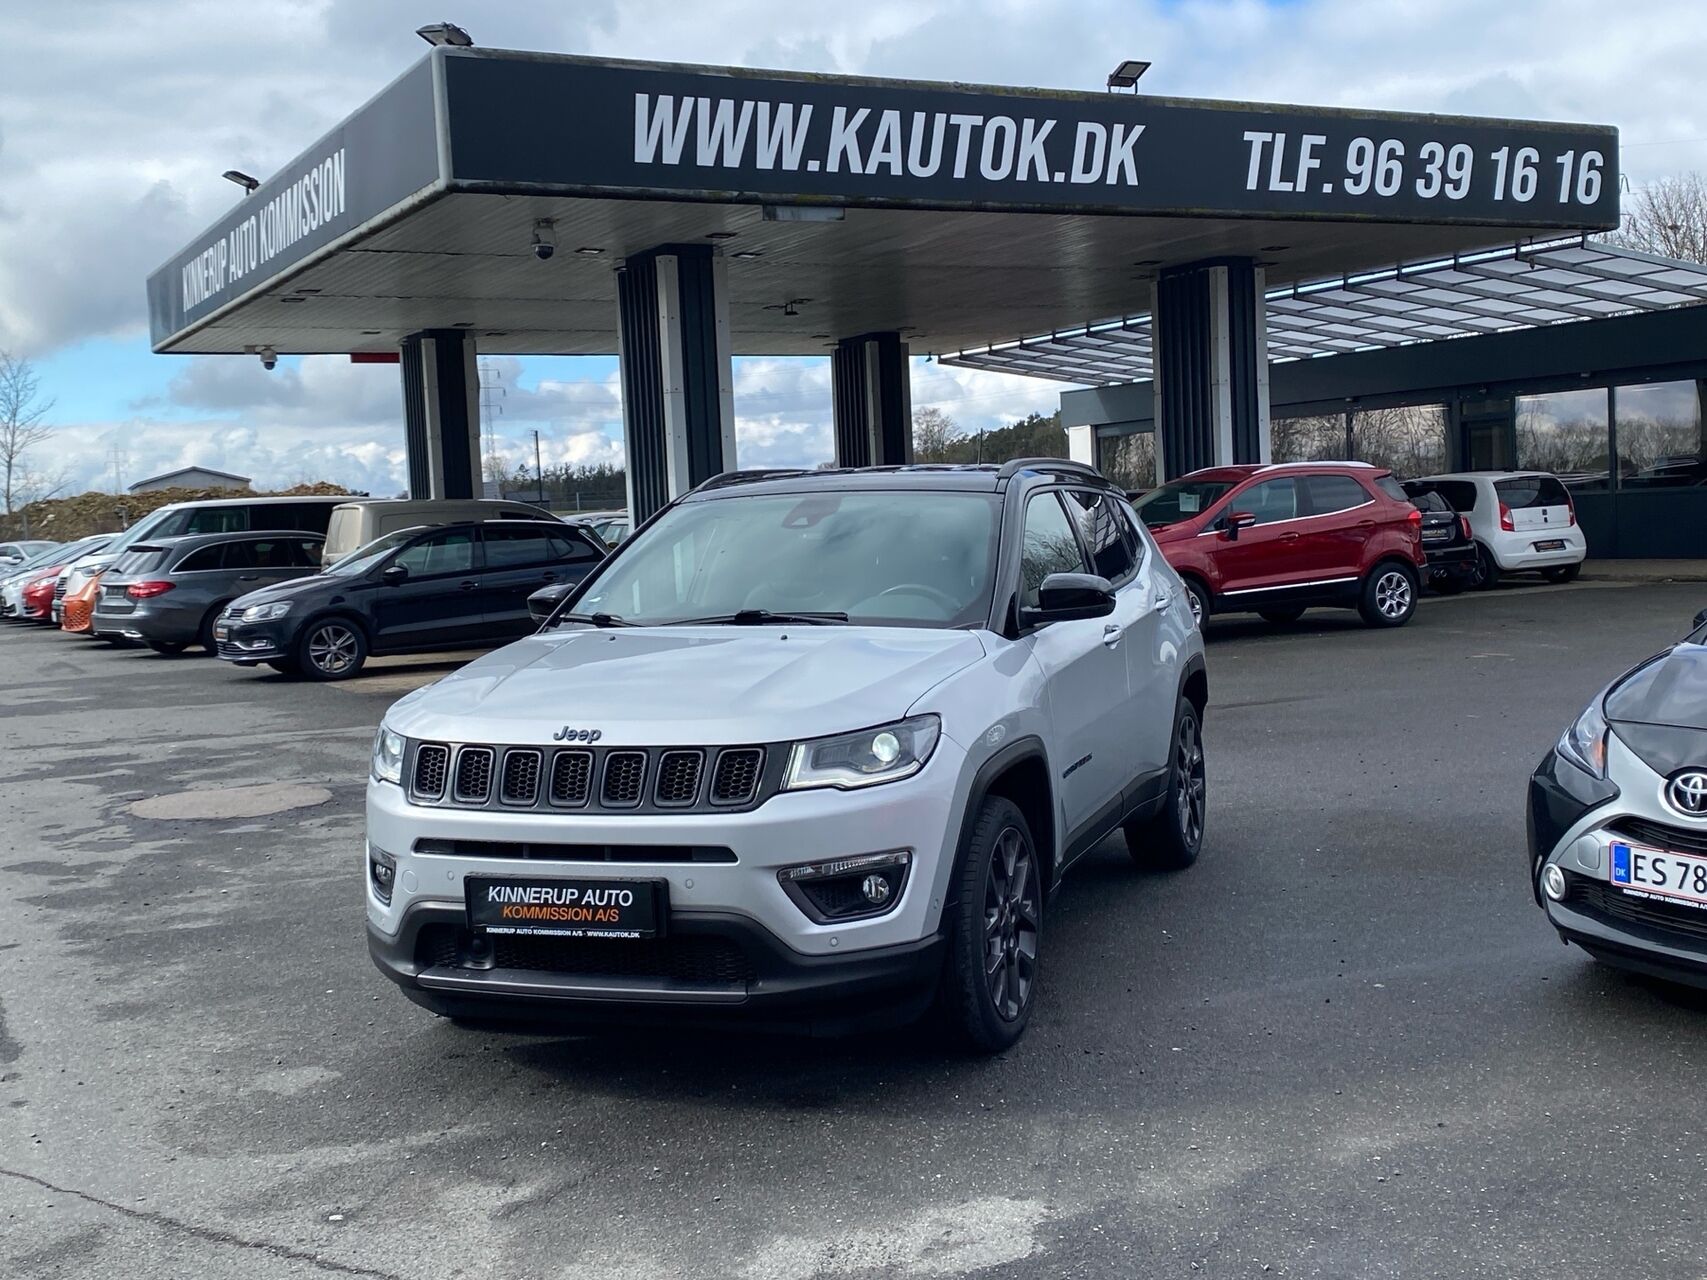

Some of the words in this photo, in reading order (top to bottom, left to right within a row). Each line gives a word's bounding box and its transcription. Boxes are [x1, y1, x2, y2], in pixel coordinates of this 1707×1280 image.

[634, 93, 1146, 186] WWW.KAUTOK.DK
[1243, 130, 1332, 193] TLF.
[1344, 136, 1405, 197] 96
[1415, 141, 1474, 200] 39
[1490, 146, 1540, 202] 16
[1556, 150, 1604, 205] 16
[182, 237, 228, 312] KINNERUP
[229, 215, 257, 283] AUTO
[259, 148, 345, 264] KOMMISSION
[553, 726, 602, 744] Jeep
[1615, 867, 1626, 877] DK
[1633, 853, 1668, 886] ES
[1676, 861, 1707, 894] 78
[488, 886, 578, 905] KINNERUP
[581, 889, 633, 907] AUTO
[502, 905, 593, 921] KOMMISSION
[594, 908, 620, 922] A/S
[516, 928, 533, 936] AUTO
